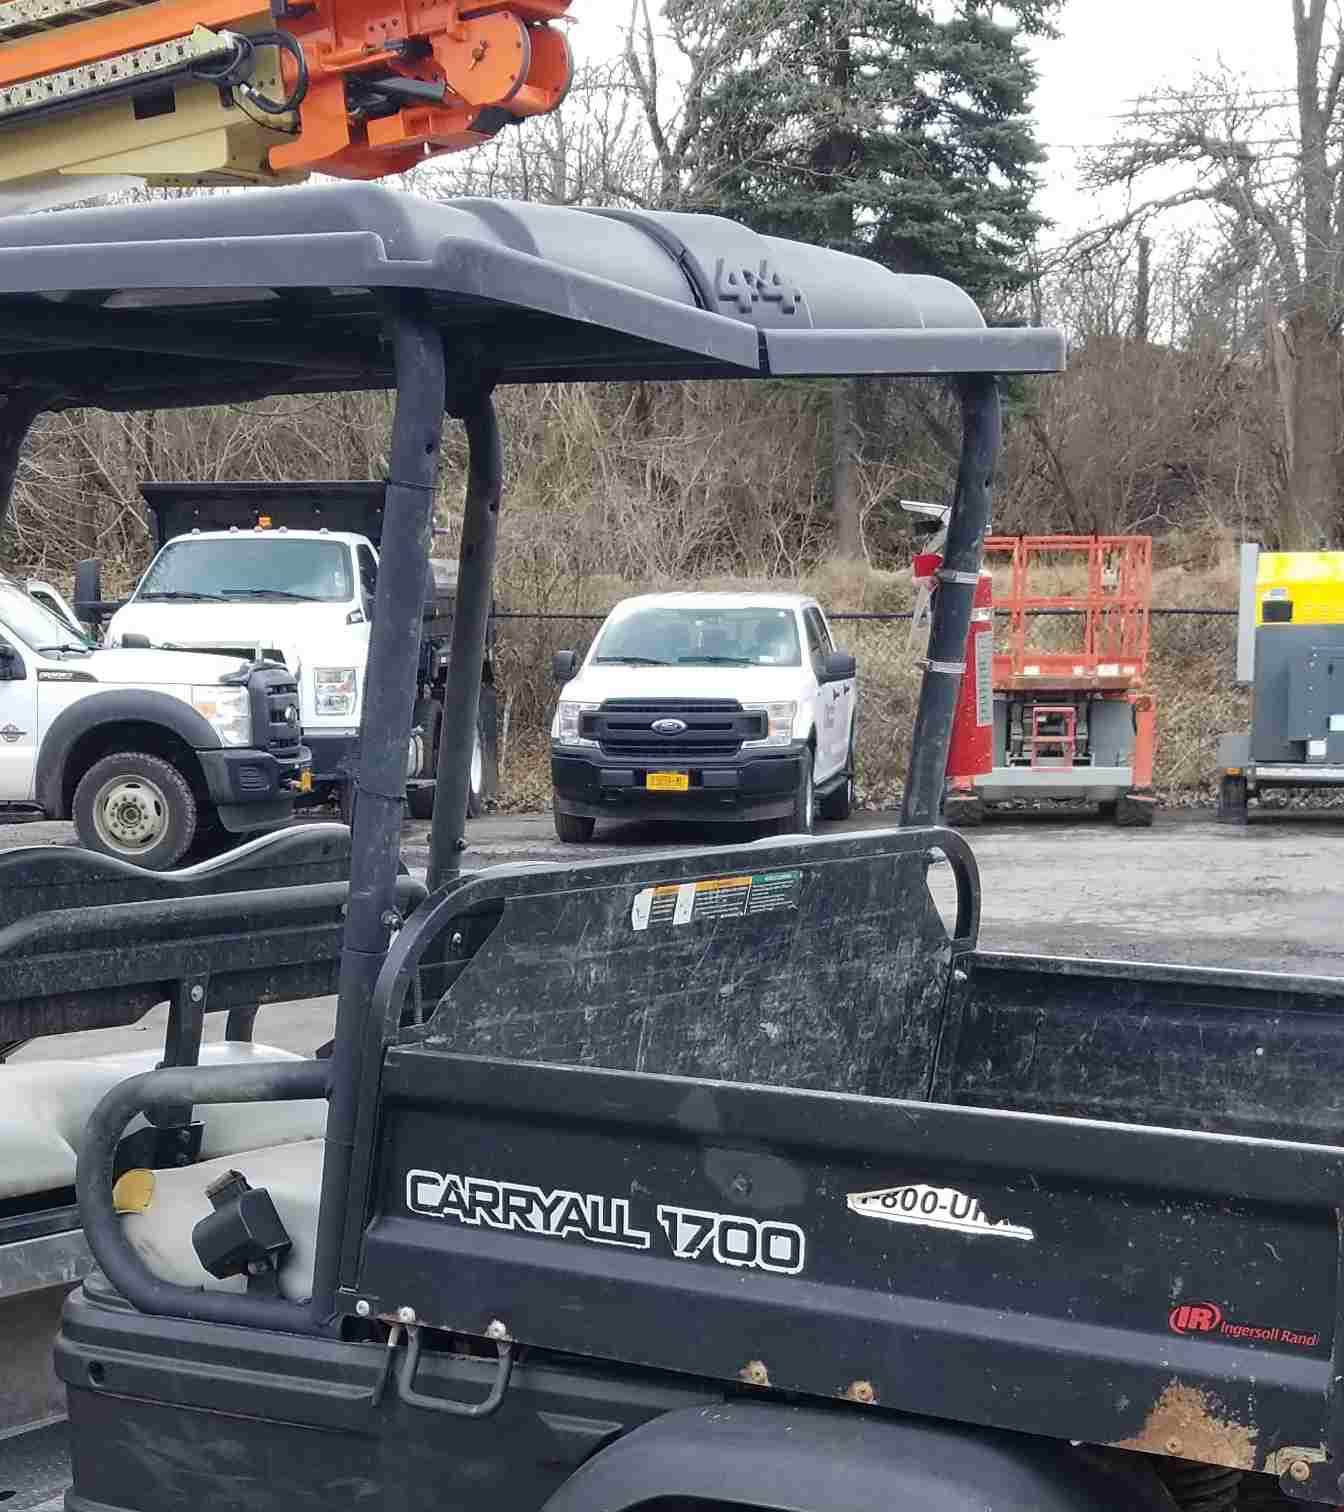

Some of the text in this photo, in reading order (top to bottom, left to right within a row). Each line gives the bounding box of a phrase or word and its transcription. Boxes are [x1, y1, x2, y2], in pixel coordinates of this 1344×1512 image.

[407, 1169, 805, 1274] CARRYALL 1700
[1220, 1320, 1281, 1340] Ingersoll
[1280, 1330, 1319, 1347] Rand
